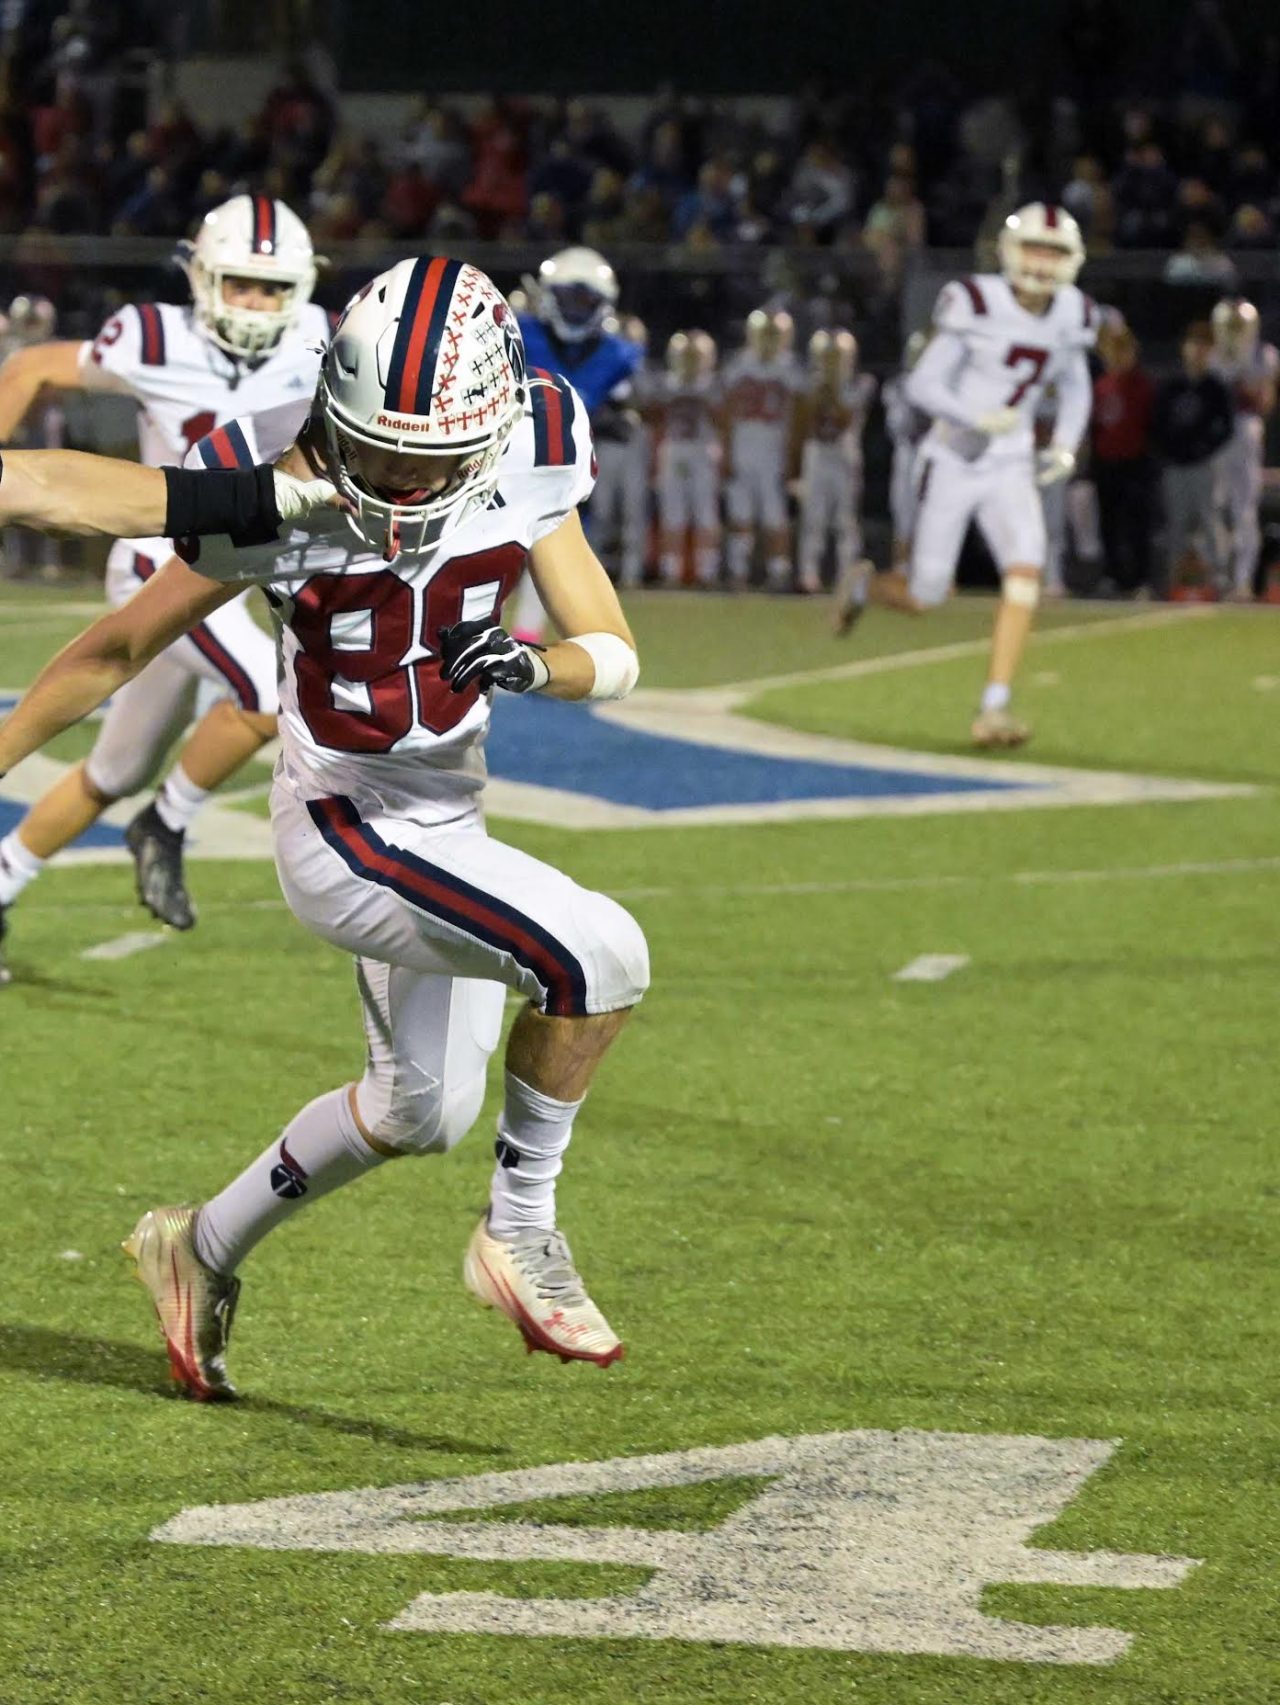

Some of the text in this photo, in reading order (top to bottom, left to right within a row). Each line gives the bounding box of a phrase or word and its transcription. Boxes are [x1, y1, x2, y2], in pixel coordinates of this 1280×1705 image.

[1005, 343, 1051, 408] 7
[377, 415, 430, 432] Riddell
[149, 1428, 1207, 1667] 4
